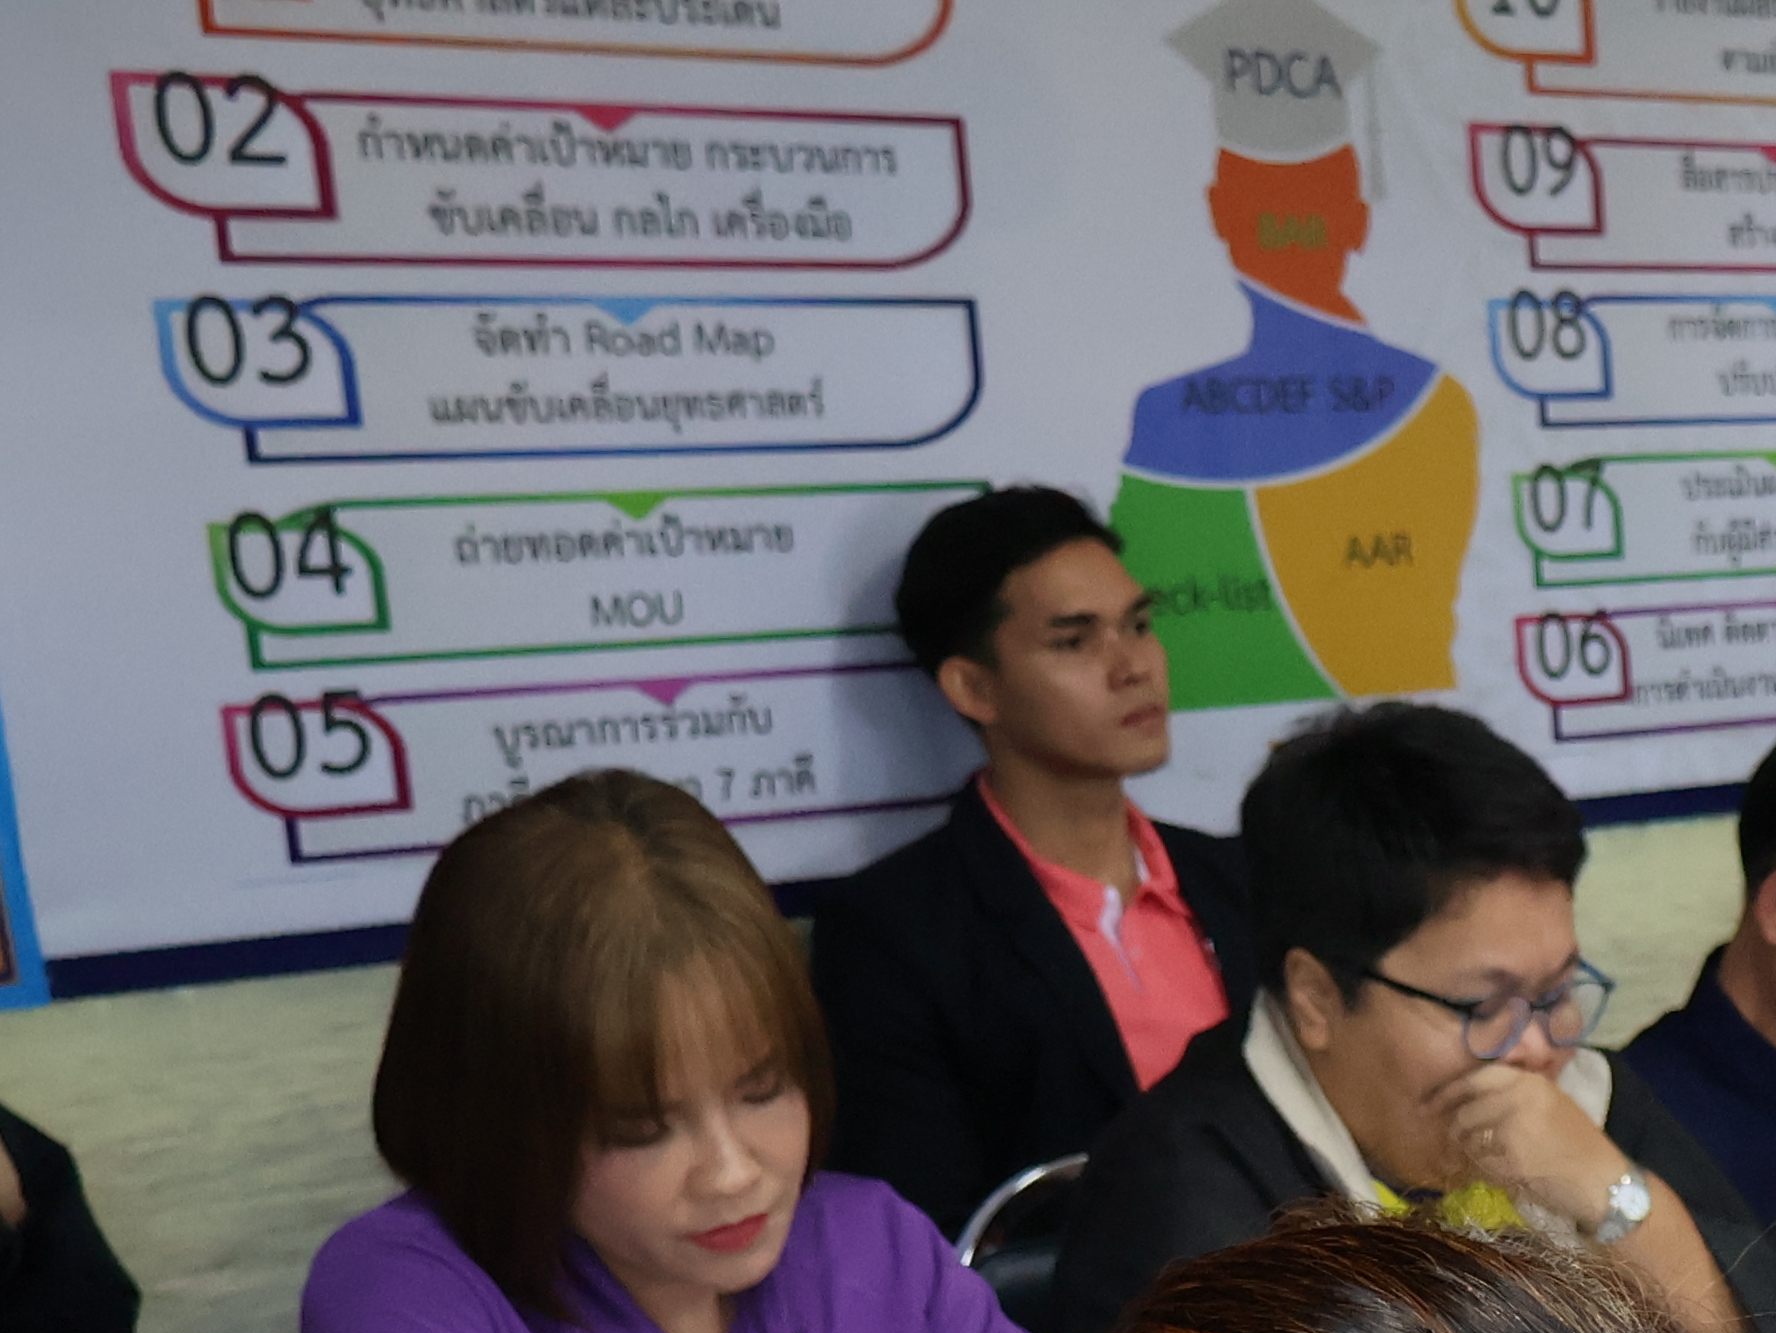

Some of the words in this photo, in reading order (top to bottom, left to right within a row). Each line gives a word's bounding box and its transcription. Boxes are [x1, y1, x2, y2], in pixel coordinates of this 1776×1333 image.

[1226, 48, 1343, 98] PDCA
[154, 73, 287, 166] 02
[1500, 126, 1580, 196] 09
[184, 295, 312, 386] 03
[473, 313, 573, 358] จัดทำ
[584, 320, 682, 358] Road
[692, 322, 776, 364] Map
[1507, 289, 1588, 360] 08
[1530, 462, 1603, 533] 07
[226, 511, 353, 599] 04
[1346, 532, 1414, 568] AAR
[589, 592, 685, 628] MOU
[1536, 611, 1611, 679] 06
[249, 689, 373, 781] 05
[716, 768, 735, 800] 7
